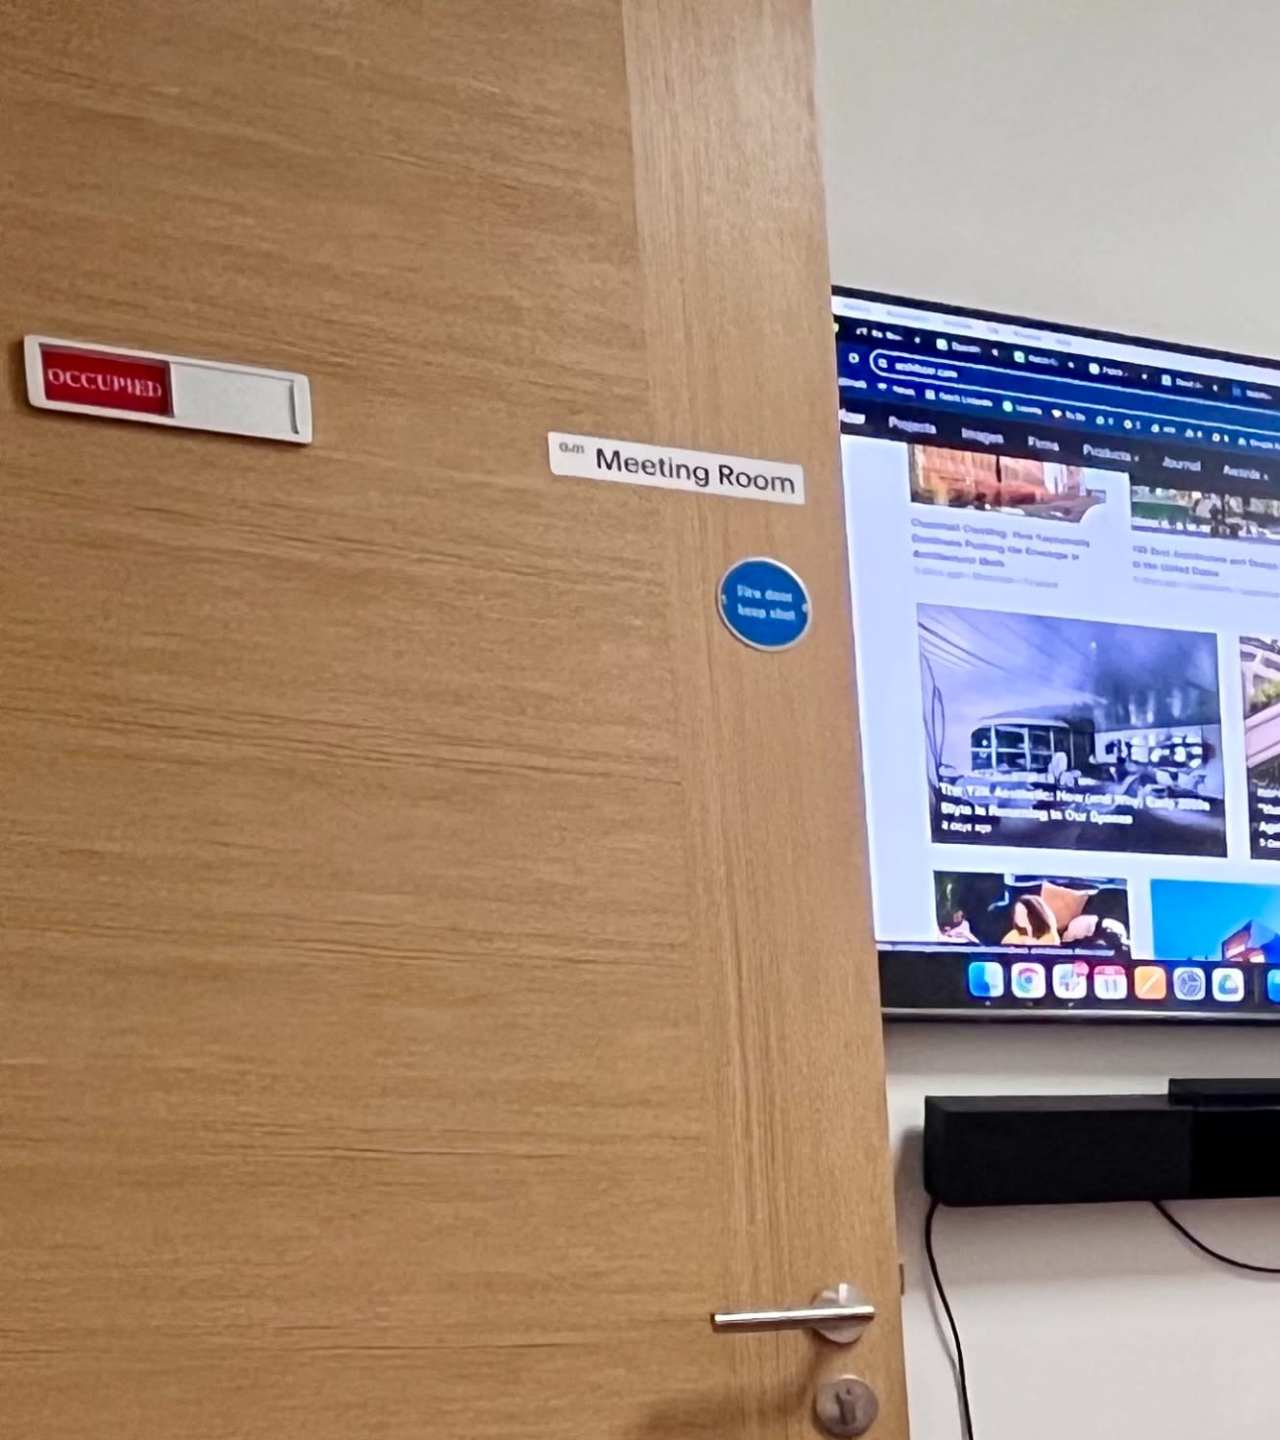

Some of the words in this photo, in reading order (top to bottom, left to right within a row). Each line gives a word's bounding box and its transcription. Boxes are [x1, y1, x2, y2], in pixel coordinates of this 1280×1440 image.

[47, 367, 162, 397] OCCUPIED
[596, 448, 709, 487] Meeting
[718, 464, 796, 495] Room
[1162, 455, 1201, 472] Journal
